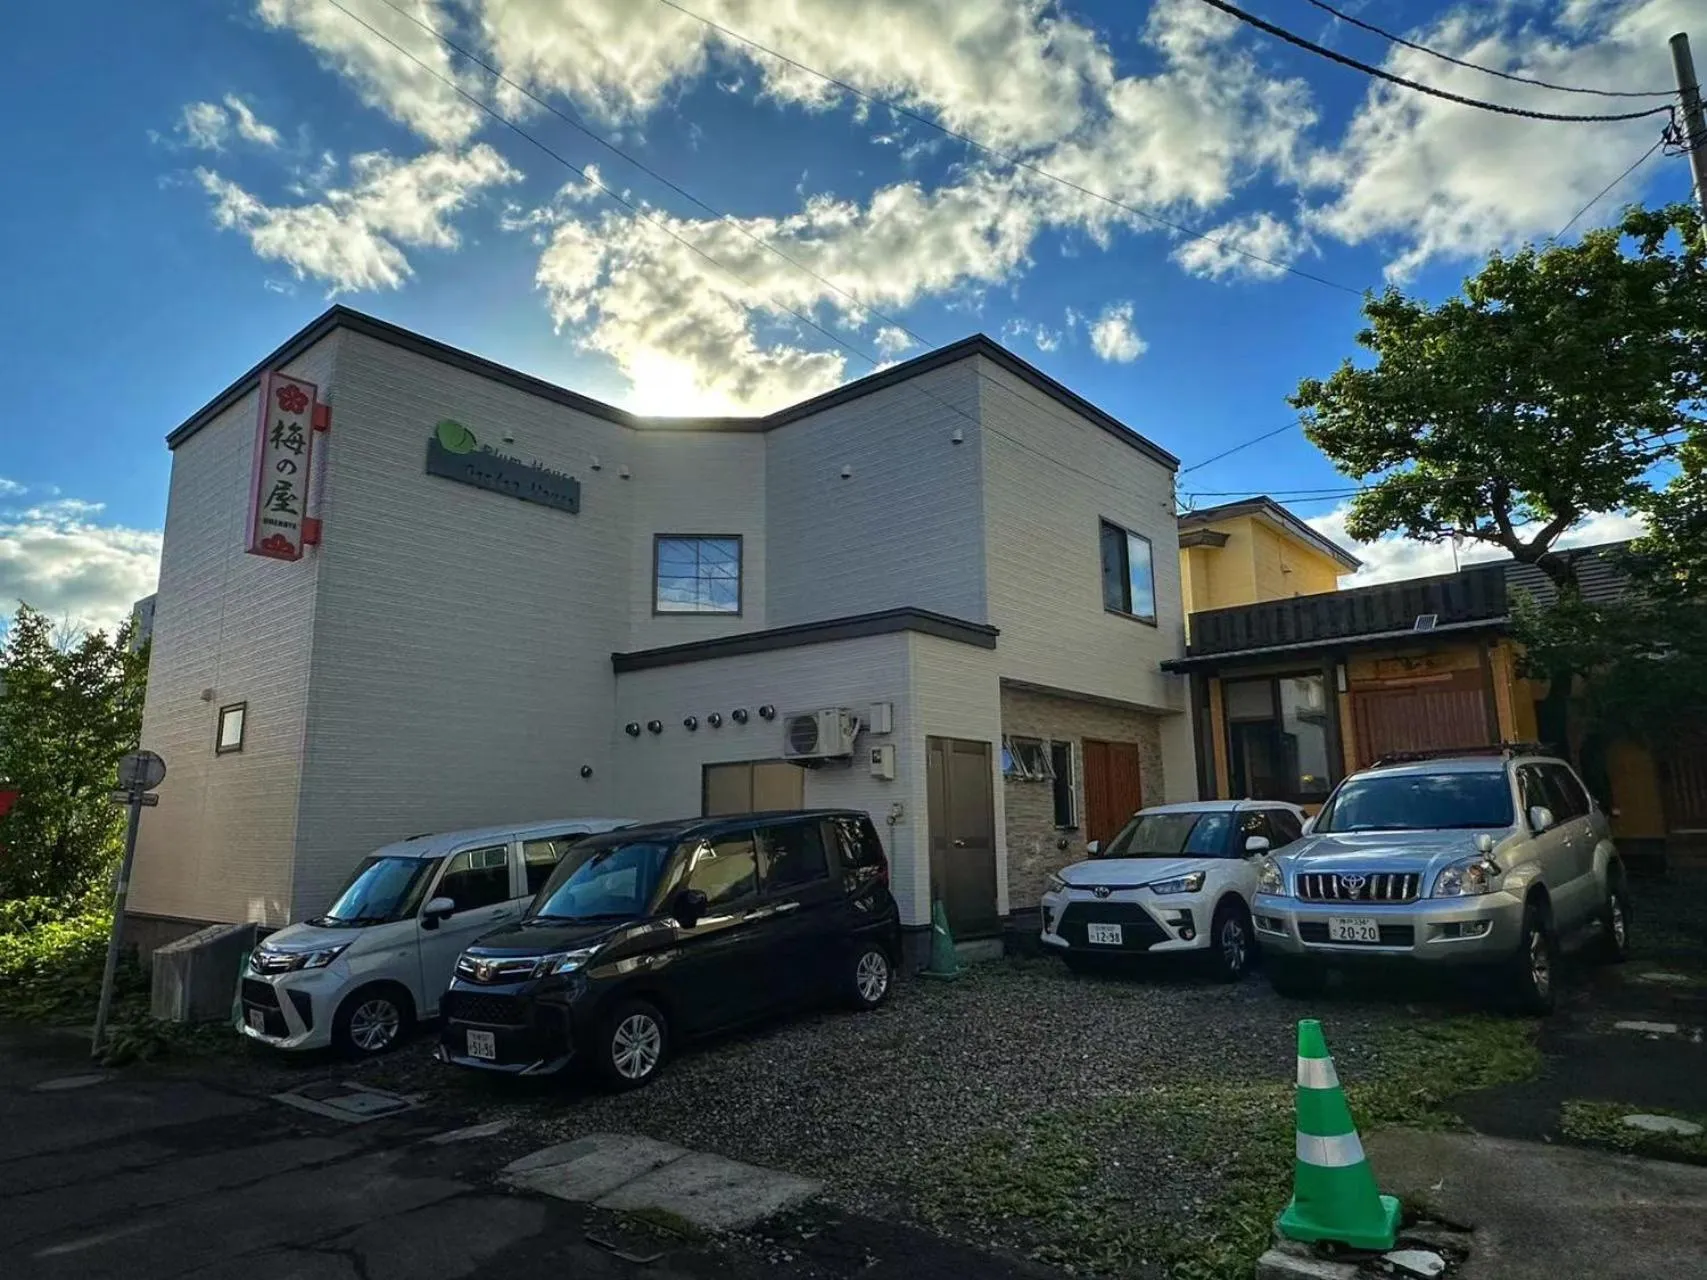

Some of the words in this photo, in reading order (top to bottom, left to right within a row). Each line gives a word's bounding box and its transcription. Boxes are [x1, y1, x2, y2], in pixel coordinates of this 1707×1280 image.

[263, 419, 307, 516] 梅の屋
[1340, 926, 1376, 940] 20-20
